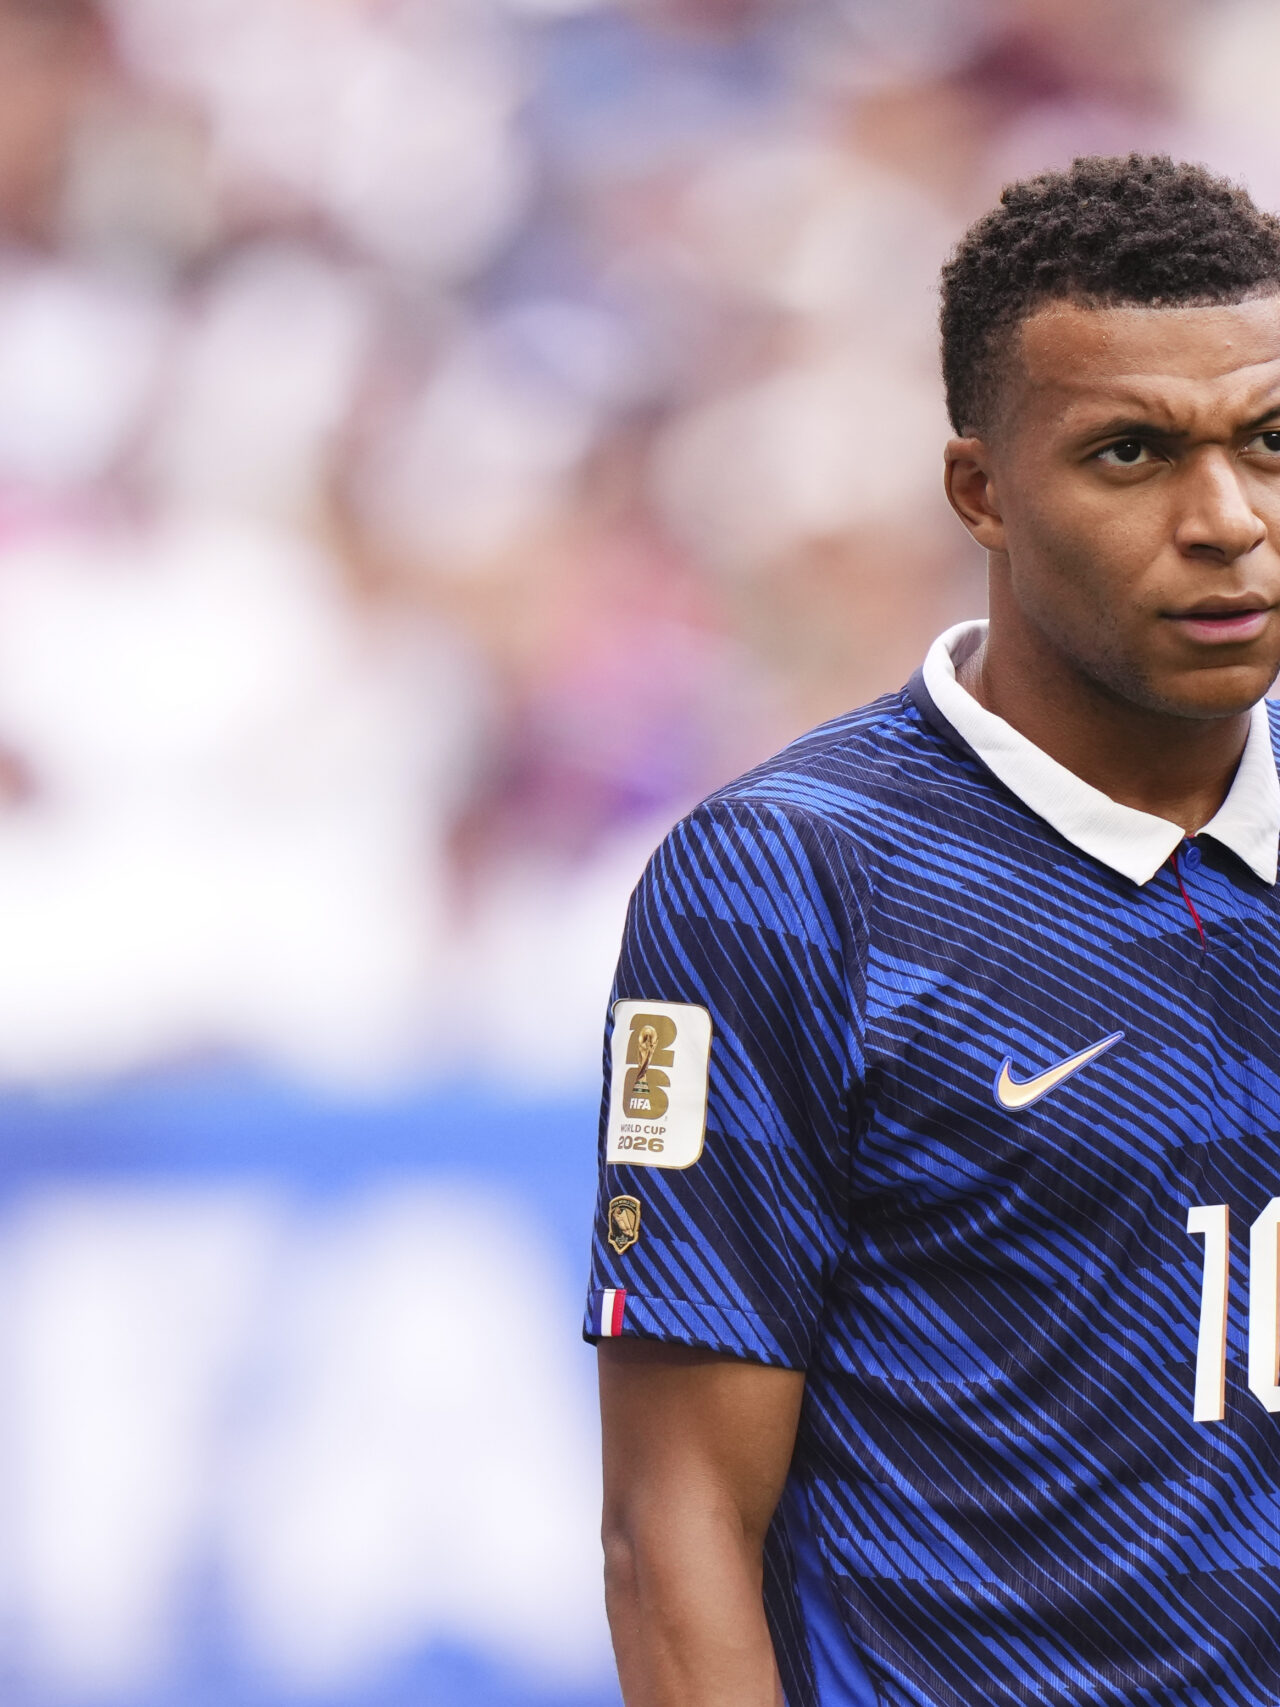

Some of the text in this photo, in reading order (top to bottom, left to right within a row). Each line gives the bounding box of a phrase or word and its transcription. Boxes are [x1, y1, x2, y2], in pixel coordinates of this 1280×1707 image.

[629, 1097, 652, 1111] FIFA
[643, 1125, 667, 1136] CUP
[617, 1135, 665, 1153] 2026
